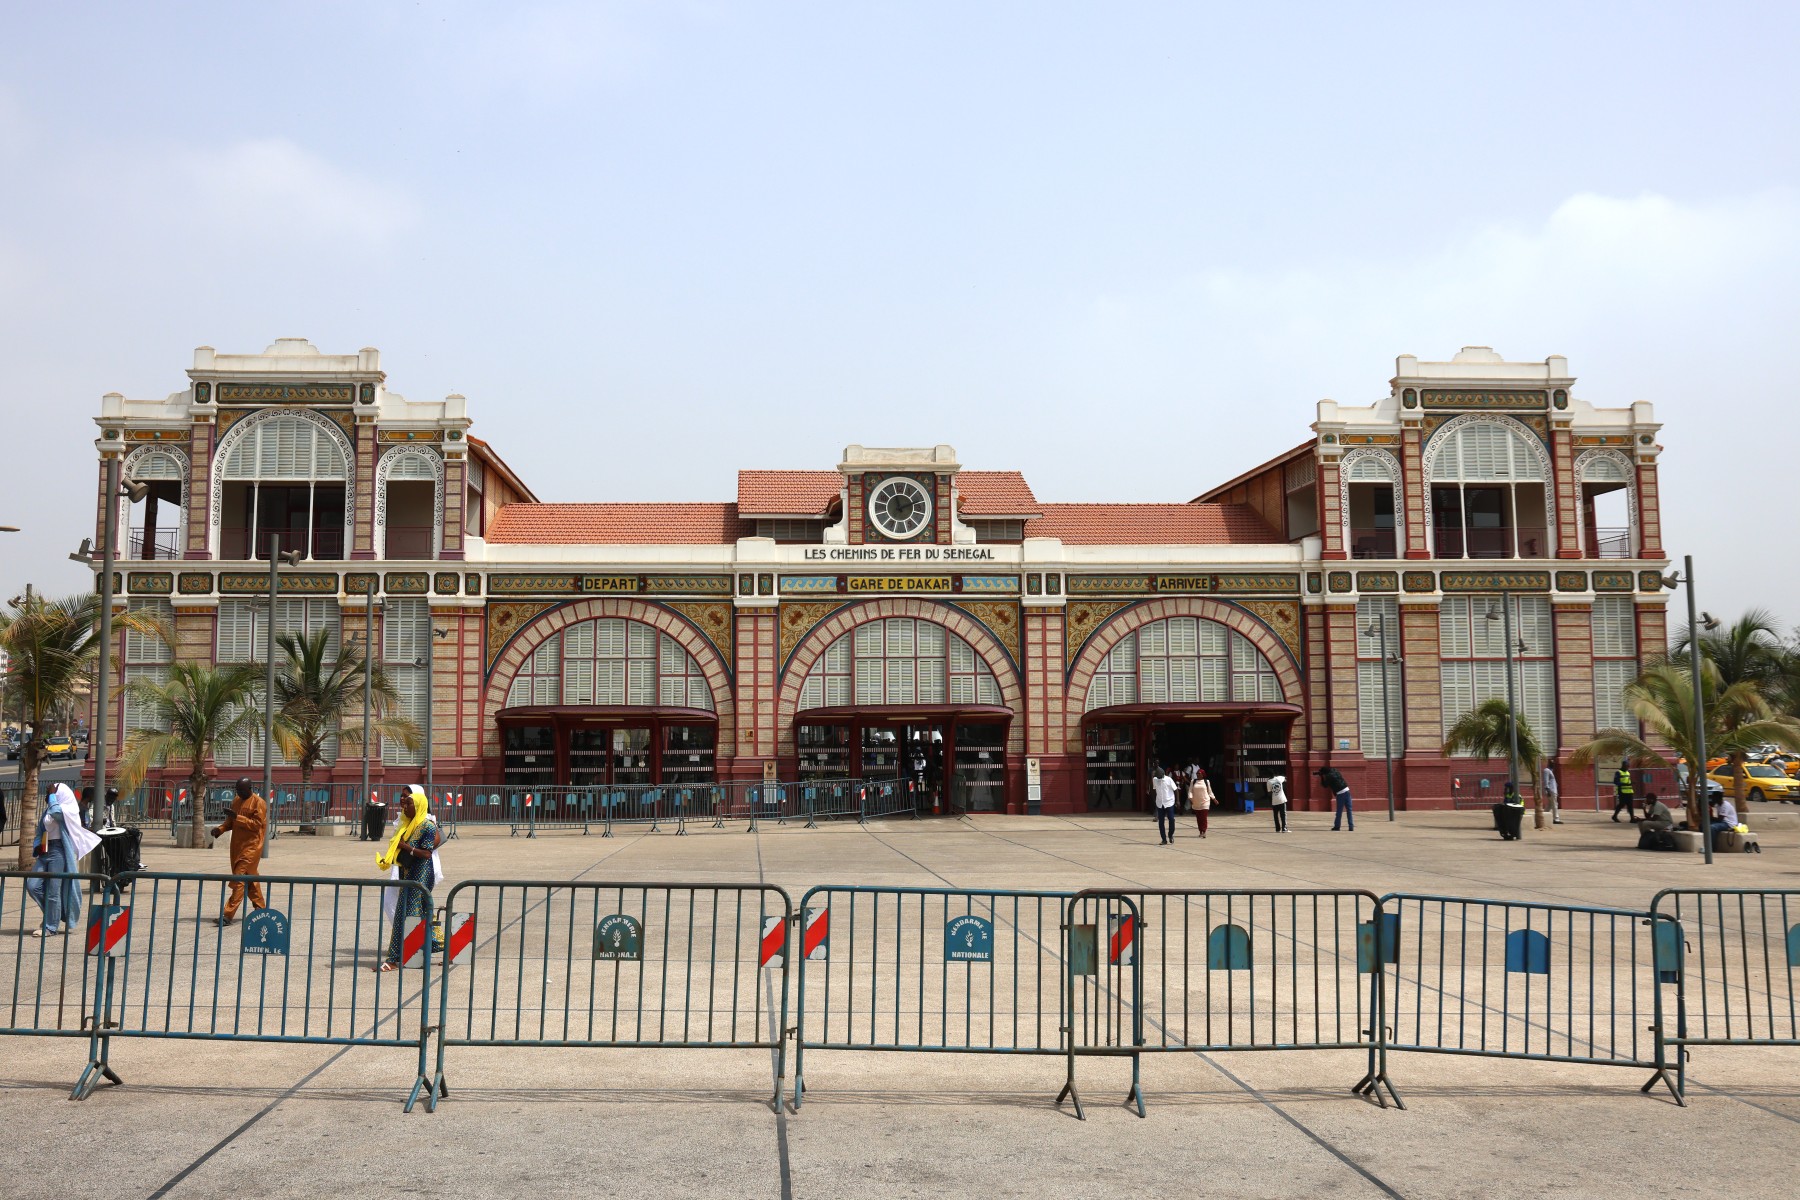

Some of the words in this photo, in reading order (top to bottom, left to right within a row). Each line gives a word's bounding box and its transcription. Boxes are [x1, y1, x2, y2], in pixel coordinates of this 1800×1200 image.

[804, 548, 826, 560] LES
[830, 548, 878, 560] CHEMINS
[881, 548, 895, 560] DE
[899, 548, 921, 560] FER
[925, 548, 940, 560] DU
[943, 548, 995, 560] SENEGAL
[584, 578, 637, 590] DEPART
[850, 578, 884, 590] GARE
[887, 578, 904, 590] DE
[907, 578, 950, 590] DAKAR
[1159, 578, 1208, 589] ARRIVEE
[951, 951, 989, 959] NATIONALE
